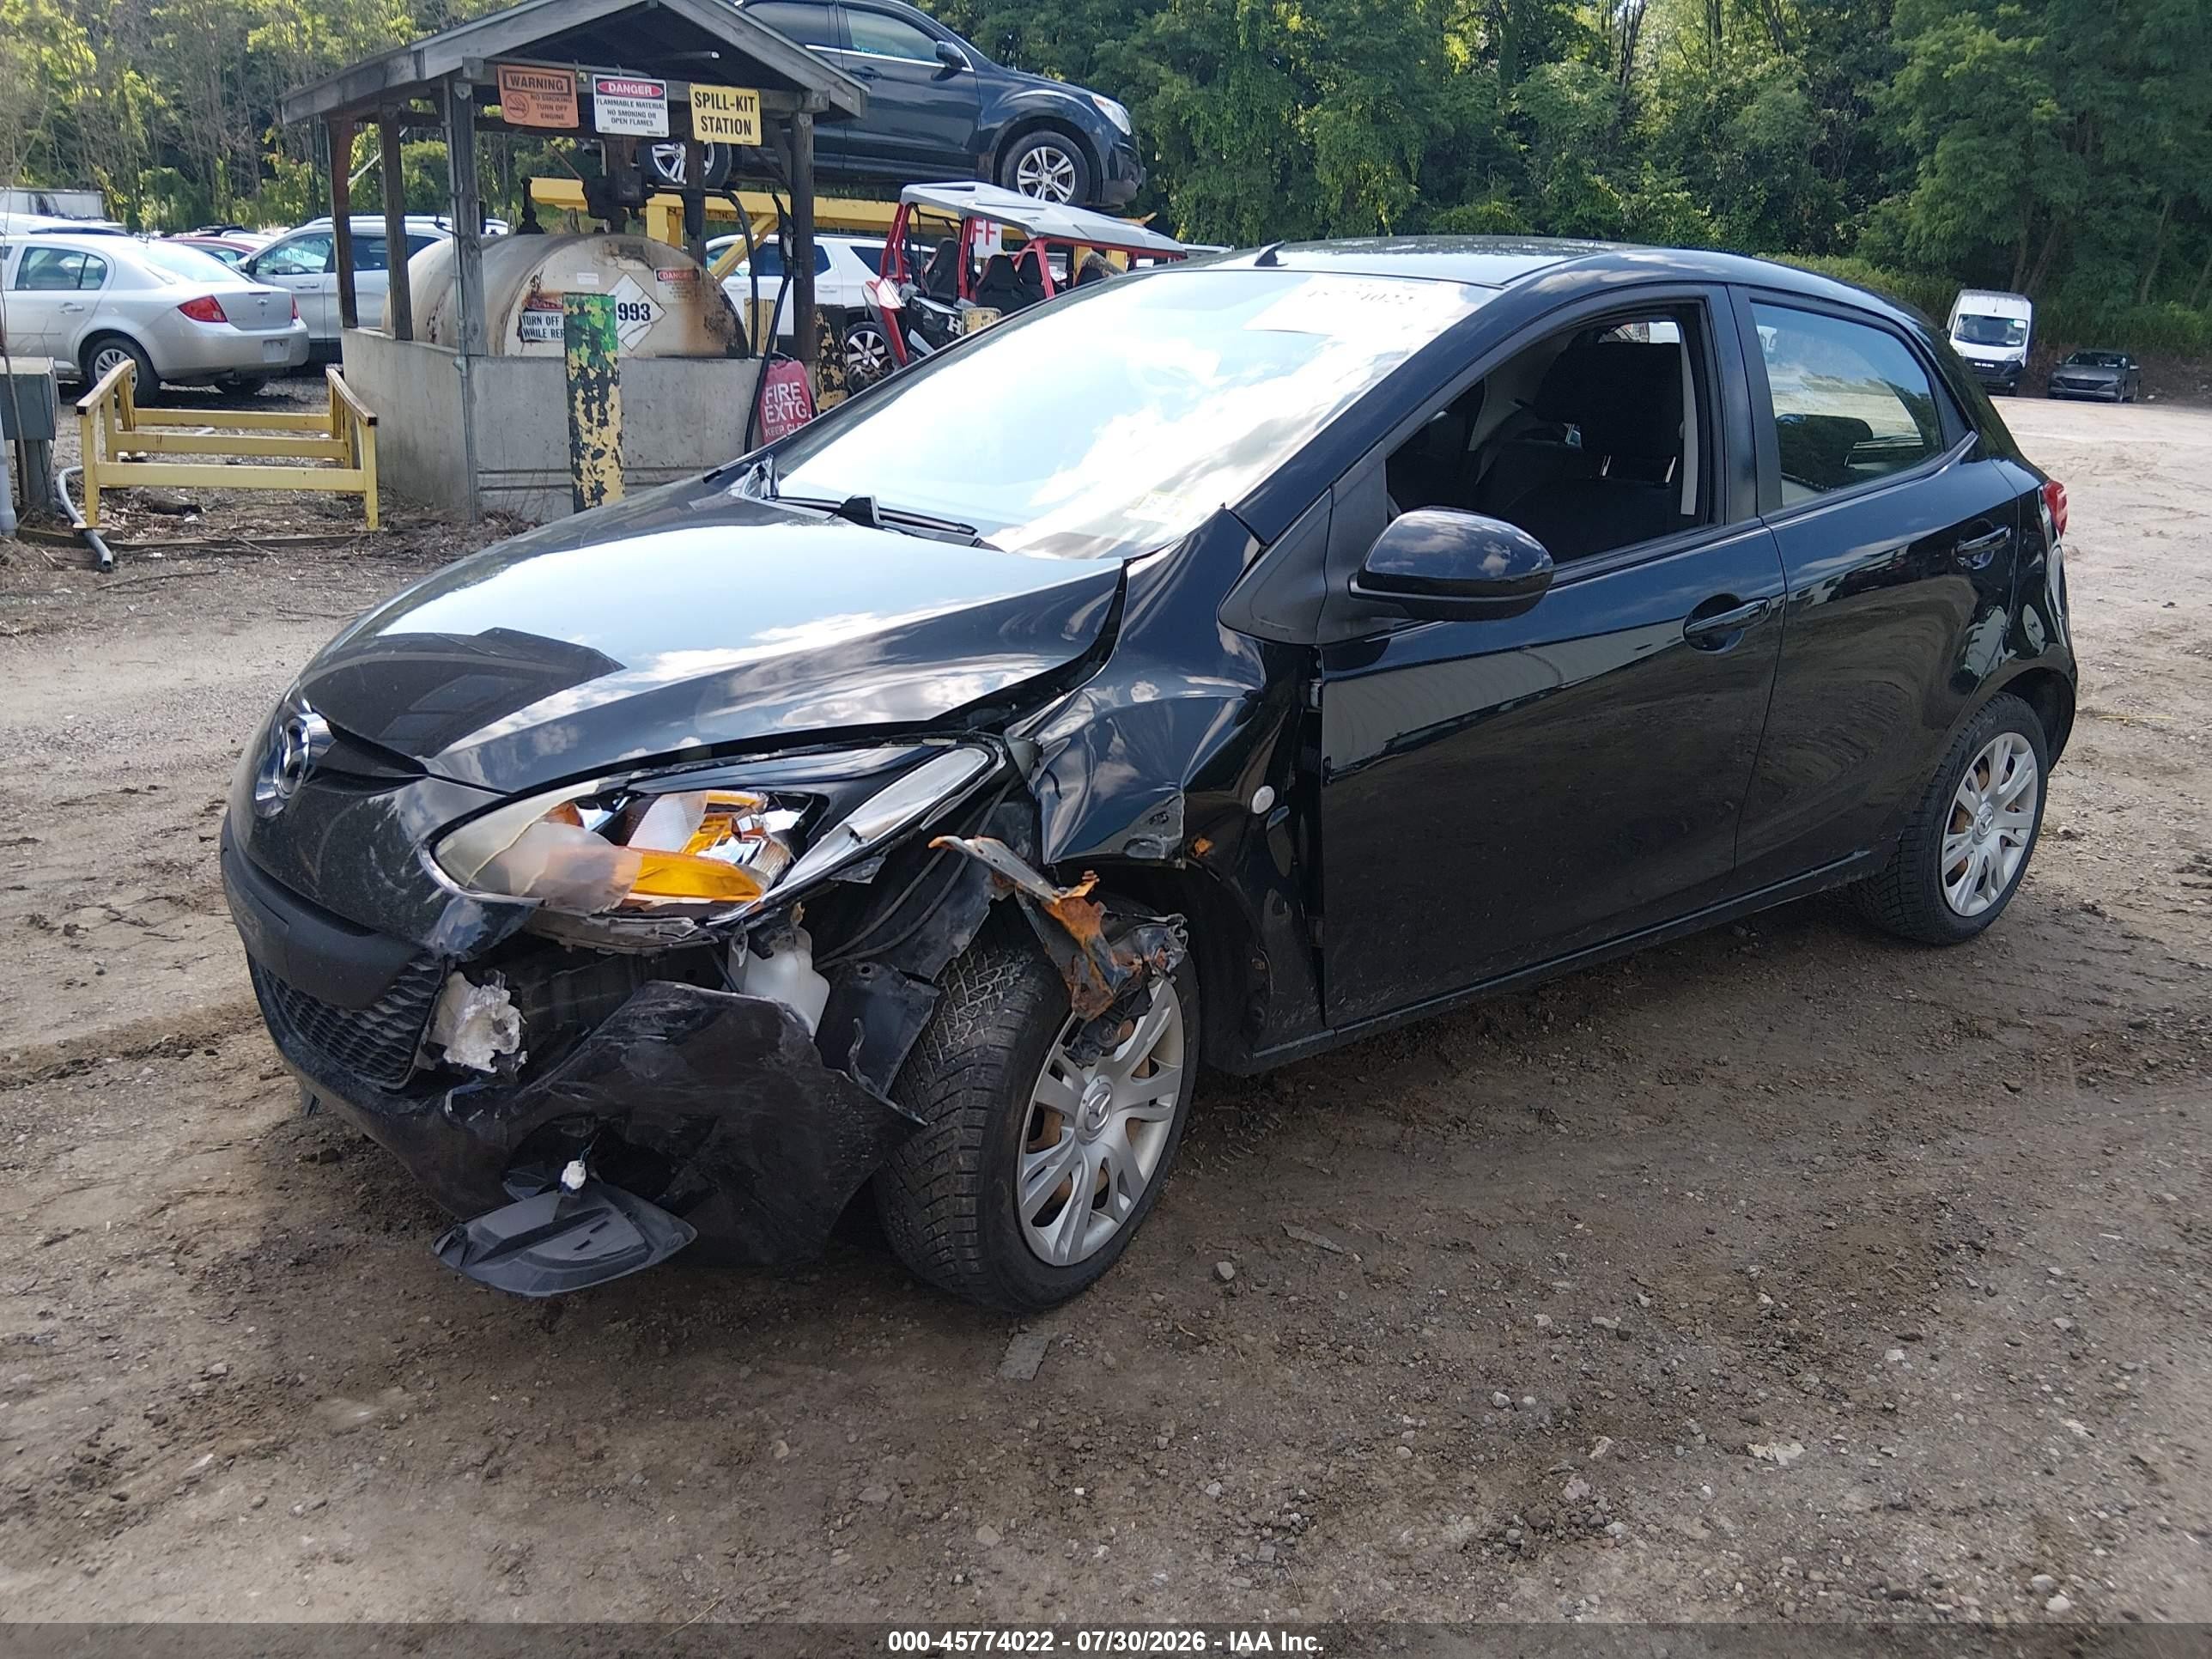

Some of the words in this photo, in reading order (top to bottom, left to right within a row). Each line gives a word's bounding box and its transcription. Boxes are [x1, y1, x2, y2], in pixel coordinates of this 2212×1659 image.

[510, 75, 563, 91] WARNING
[608, 82, 653, 96] DANGER
[542, 94, 573, 103] SMOKING
[596, 98, 635, 107] FLAMMABLE
[635, 101, 665, 110] MATERIAL
[694, 91, 756, 113] SPILL-KIT
[617, 110, 647, 118] SMOKING
[629, 118, 653, 127] FLAMES
[701, 115, 752, 136] STATION
[522, 315, 543, 326] TURN
[545, 315, 560, 326] OFF
[523, 328, 547, 338] WHILE
[765, 381, 803, 404] FIRE
[763, 400, 813, 424] EXTG.
[764, 424, 785, 437] KEEP
[787, 422, 805, 434] CLE
